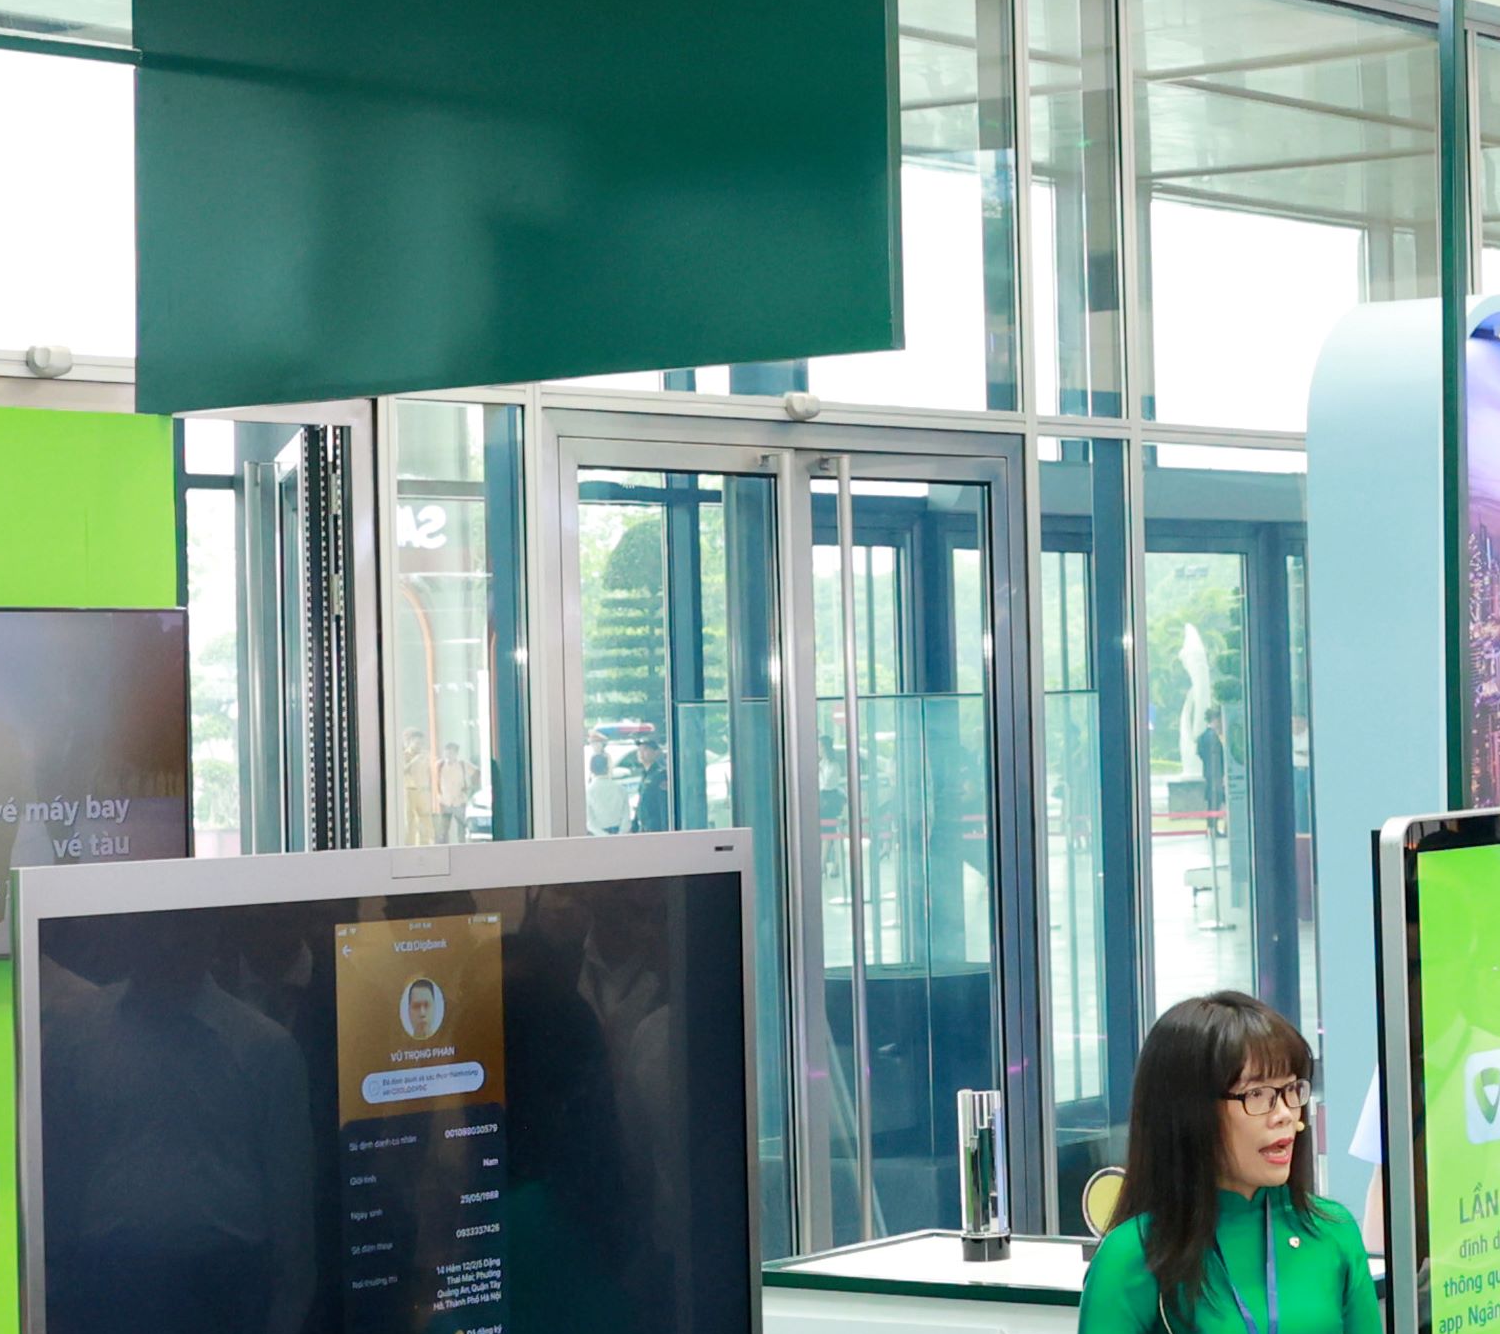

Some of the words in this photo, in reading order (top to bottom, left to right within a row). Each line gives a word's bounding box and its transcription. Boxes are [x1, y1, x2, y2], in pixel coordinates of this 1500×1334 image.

[25, 795, 80, 826] máy
[86, 794, 131, 824] bay
[53, 831, 82, 859] vé
[89, 832, 131, 857] tàu
[1459, 1182, 1499, 1224] LẦN
[1459, 1237, 1488, 1263] định
[1443, 1273, 1483, 1299] thông
